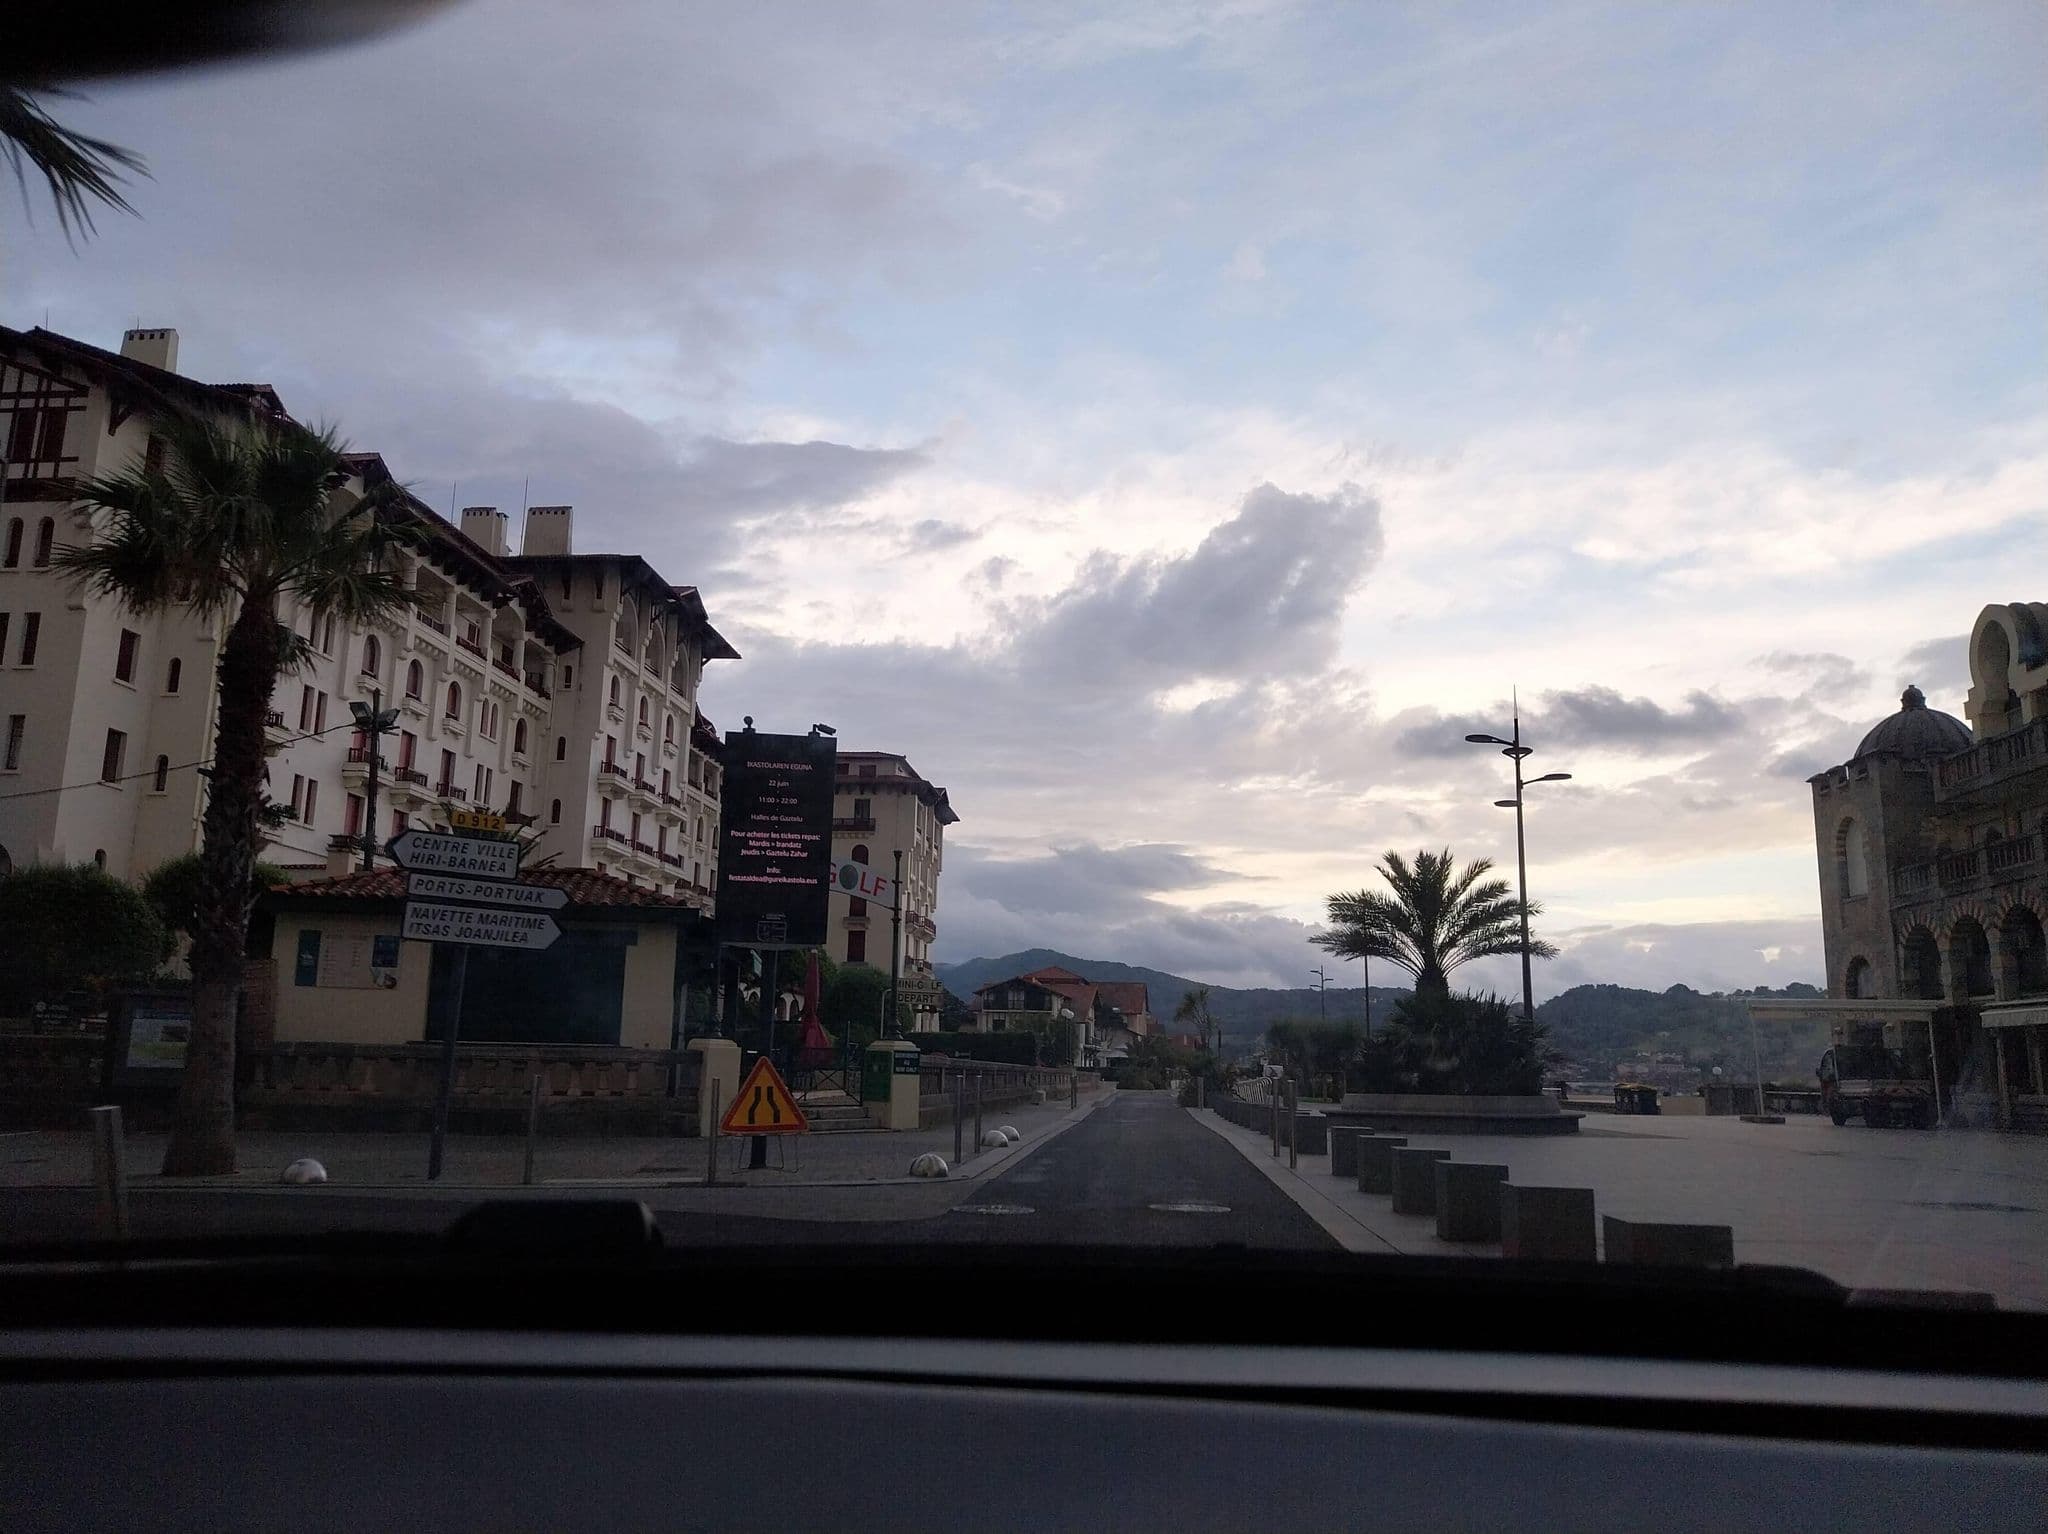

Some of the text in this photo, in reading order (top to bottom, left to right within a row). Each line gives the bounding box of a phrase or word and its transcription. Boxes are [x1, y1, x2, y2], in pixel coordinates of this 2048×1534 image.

[747, 761, 813, 771] IKASTOLAREN EGUNA
[777, 780, 790, 788] juin
[457, 813, 500, 829] D 912
[730, 830, 746, 838] Pour
[412, 836, 515, 860] CENTRE VILLE
[409, 853, 507, 873] HIRI-BARNEA
[410, 907, 546, 930] NAVETTE MARITIME
[408, 922, 528, 944] ITSAS JOANJILEA
